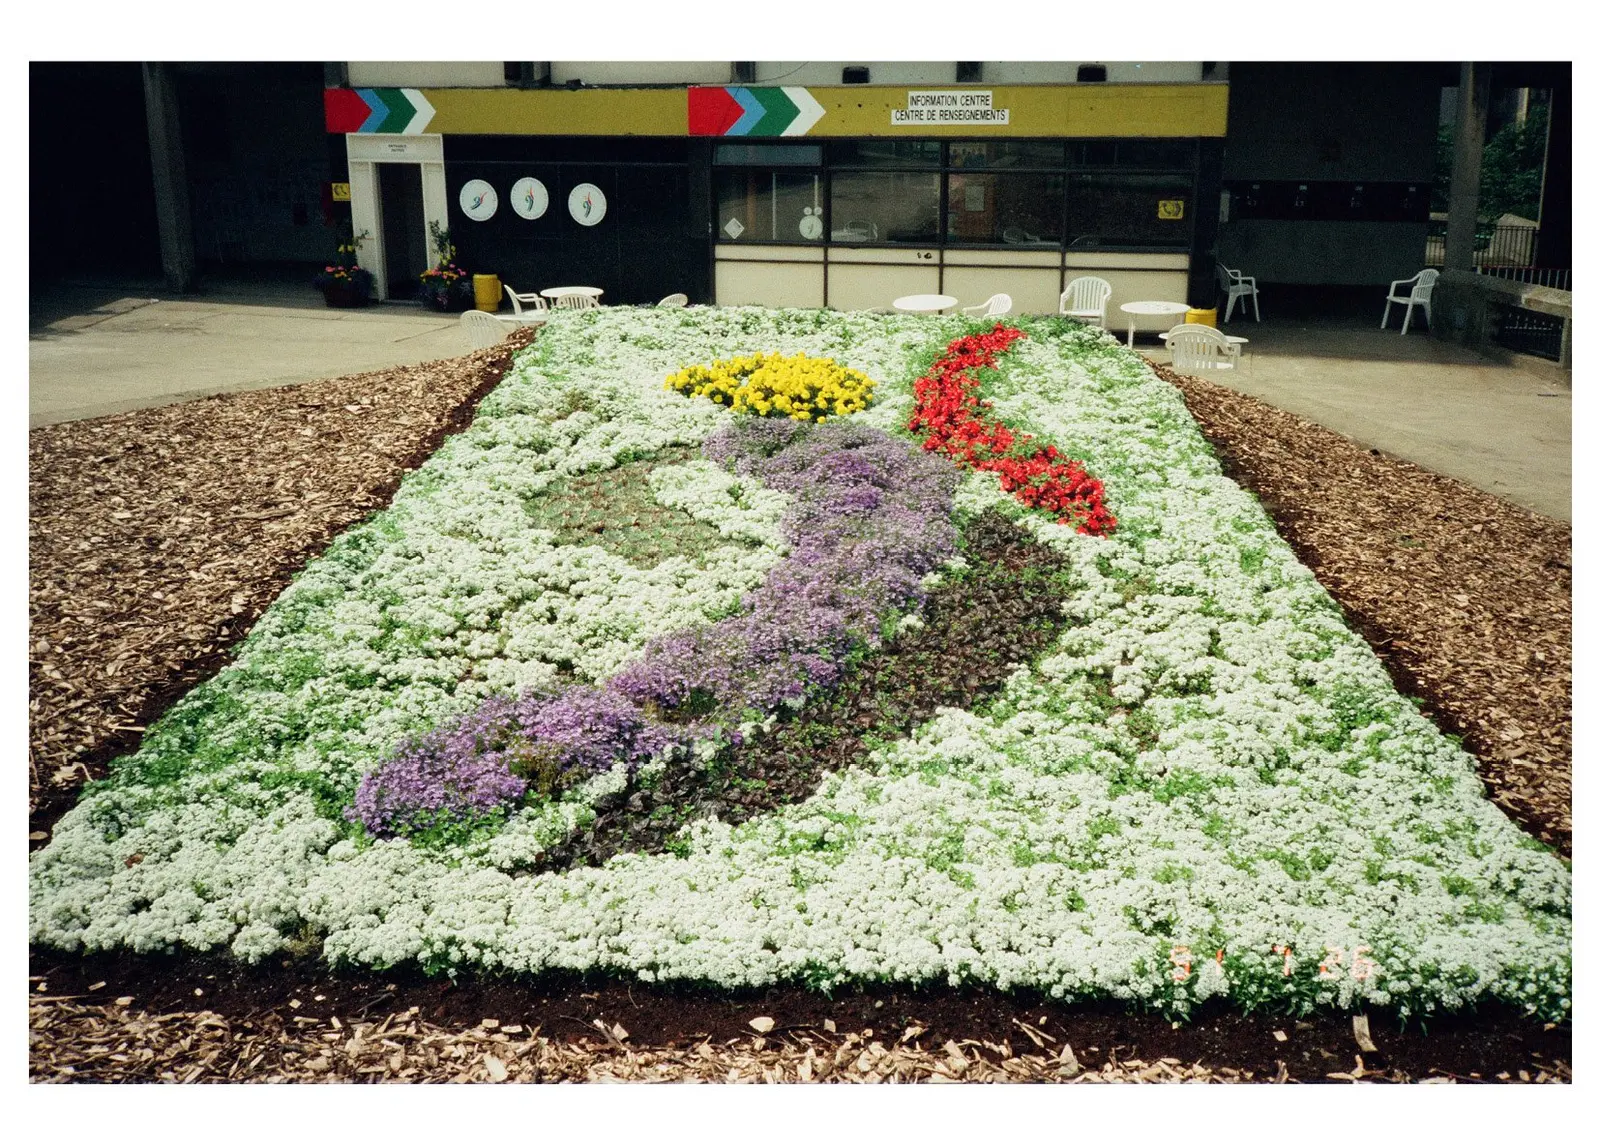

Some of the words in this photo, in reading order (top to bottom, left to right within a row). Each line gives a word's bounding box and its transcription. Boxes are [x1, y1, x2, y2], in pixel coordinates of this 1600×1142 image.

[910, 95, 957, 106] INFORMATION
[961, 95, 990, 106] CENTRE
[895, 110, 924, 121] CENTRE
[927, 110, 936, 121] DE
[940, 110, 1006, 121] RENSEIGNEMENTS
